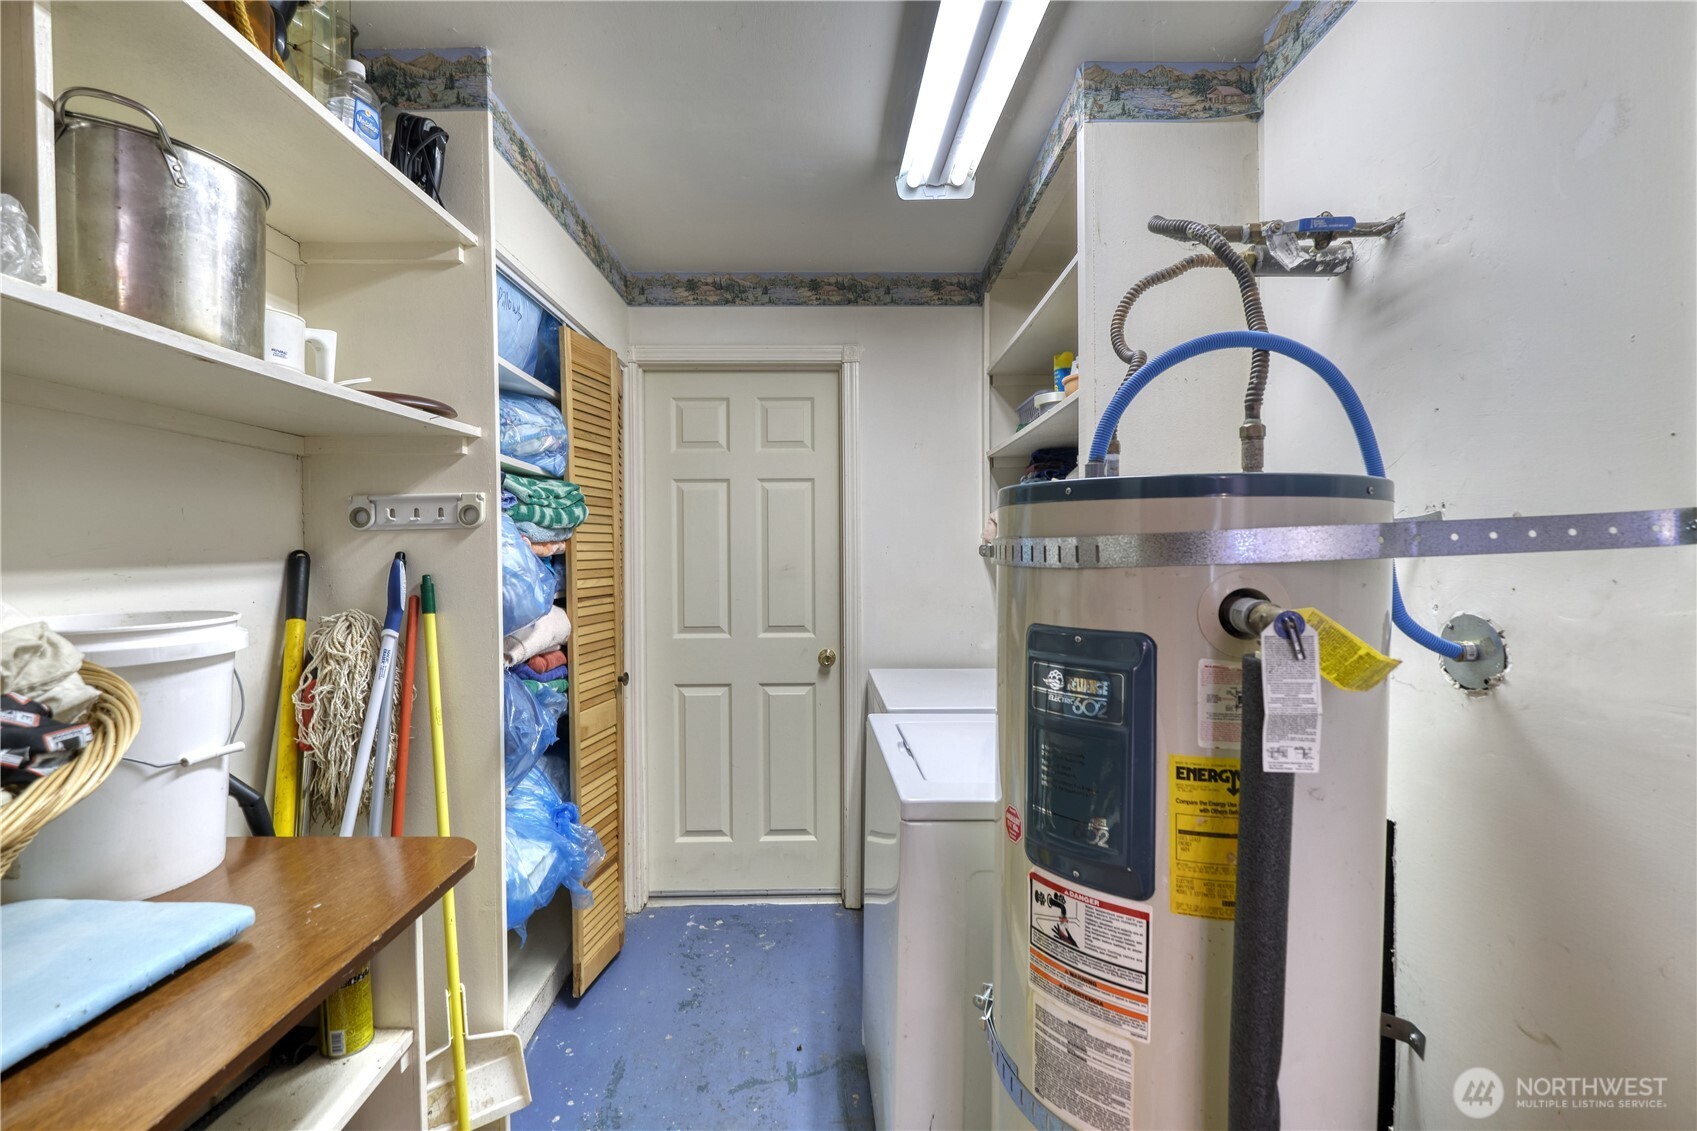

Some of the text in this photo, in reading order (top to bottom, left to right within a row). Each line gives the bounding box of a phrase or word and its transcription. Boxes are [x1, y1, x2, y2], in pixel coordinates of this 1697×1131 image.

[1072, 697, 1108, 718] 602
[1070, 891, 1100, 907] DANGER
[1069, 970, 1097, 987] WARNING
